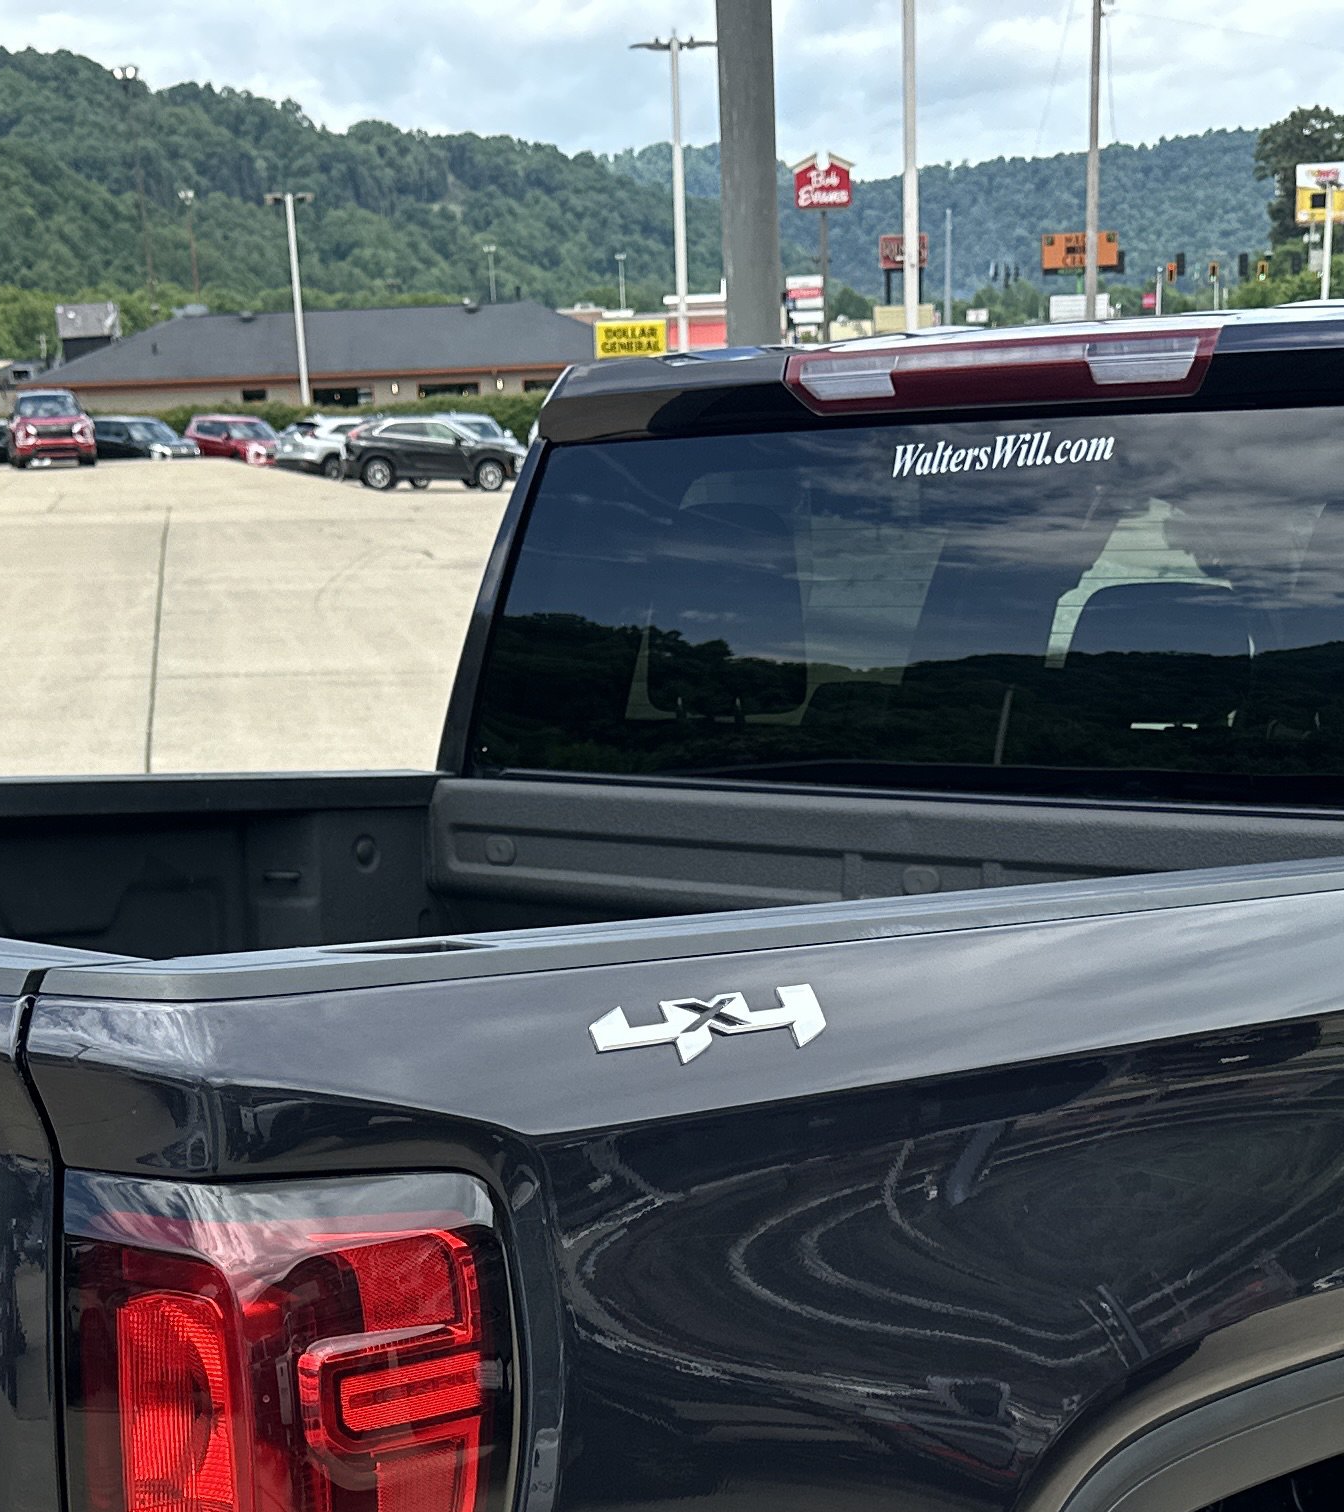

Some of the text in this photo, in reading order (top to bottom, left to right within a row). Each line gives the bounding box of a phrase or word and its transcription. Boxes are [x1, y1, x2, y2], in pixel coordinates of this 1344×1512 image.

[806, 170, 841, 188] Bob
[798, 185, 850, 207] Evans
[604, 326, 658, 340] DOLLAR
[600, 340, 661, 354] GENERAL
[892, 431, 1115, 479] WaltersWill.com
